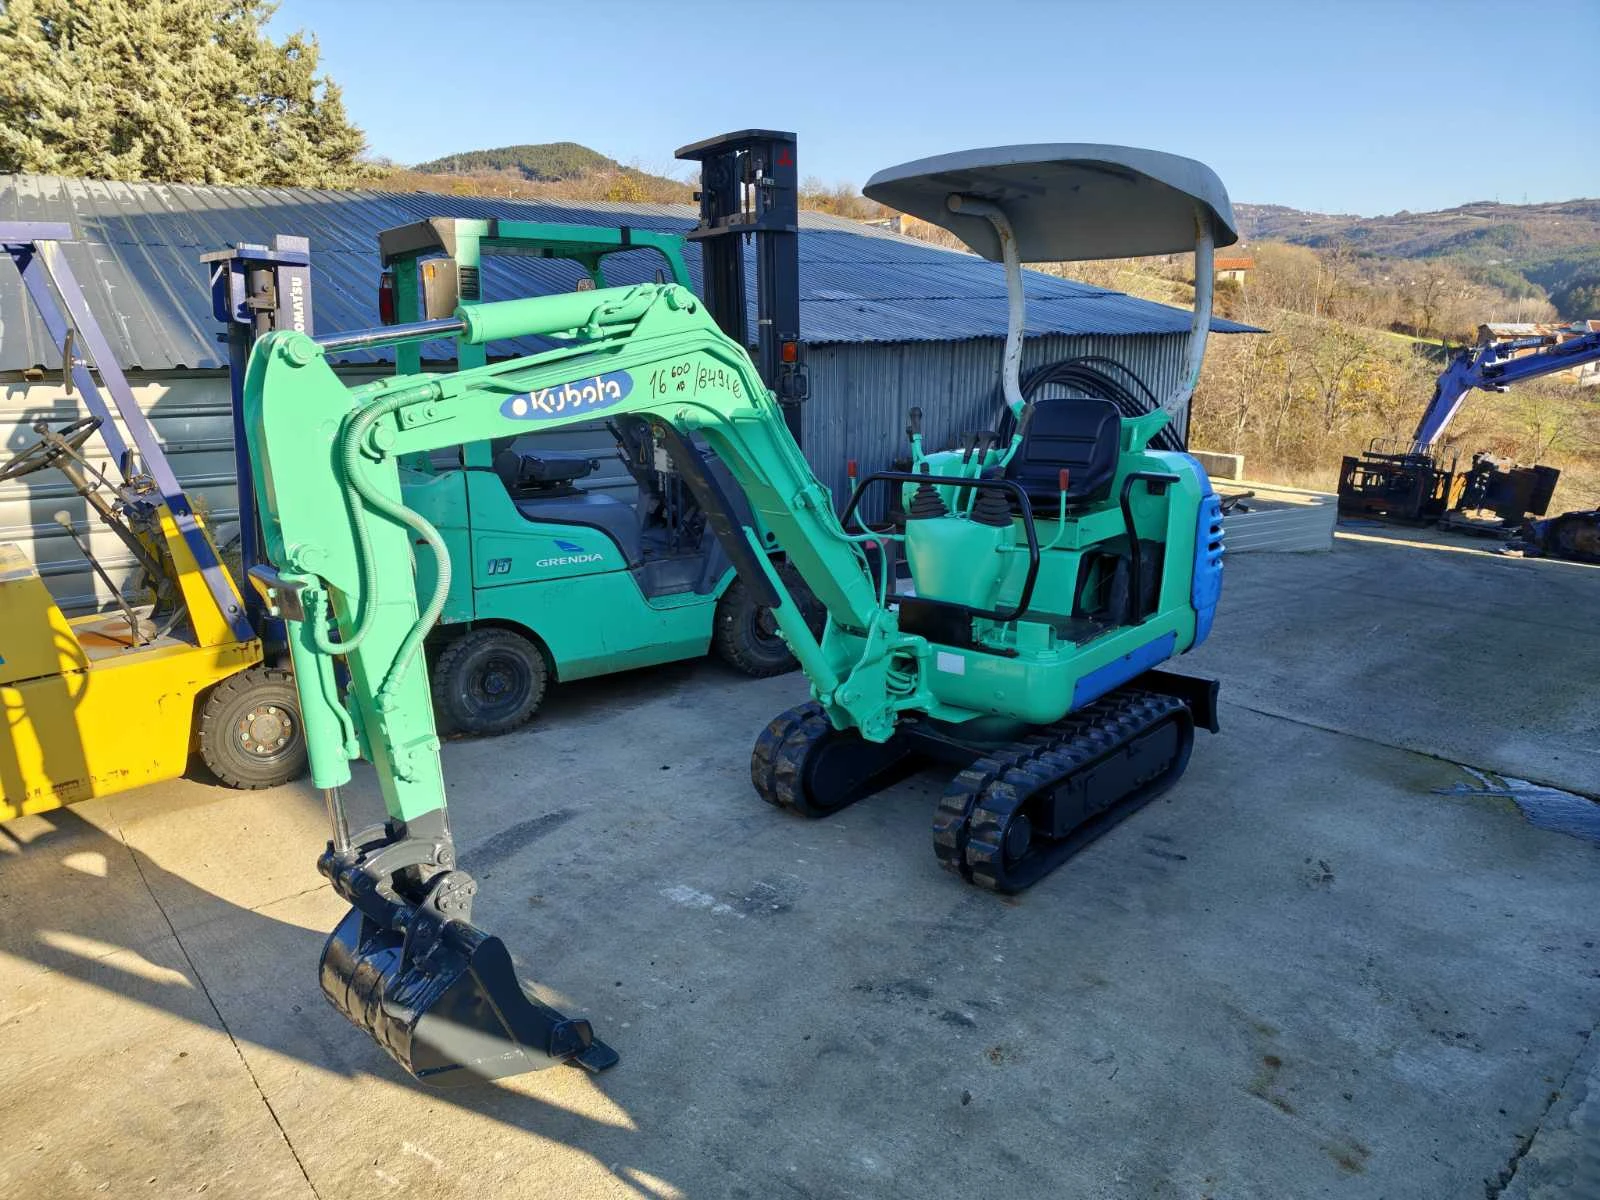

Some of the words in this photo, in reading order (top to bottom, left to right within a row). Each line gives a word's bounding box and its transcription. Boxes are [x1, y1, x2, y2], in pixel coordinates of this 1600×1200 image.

[289, 276, 305, 334] OMATSU
[529, 375, 621, 413] Kubota
[649, 369, 666, 400] 16
[535, 553, 603, 568] GRENDIA
